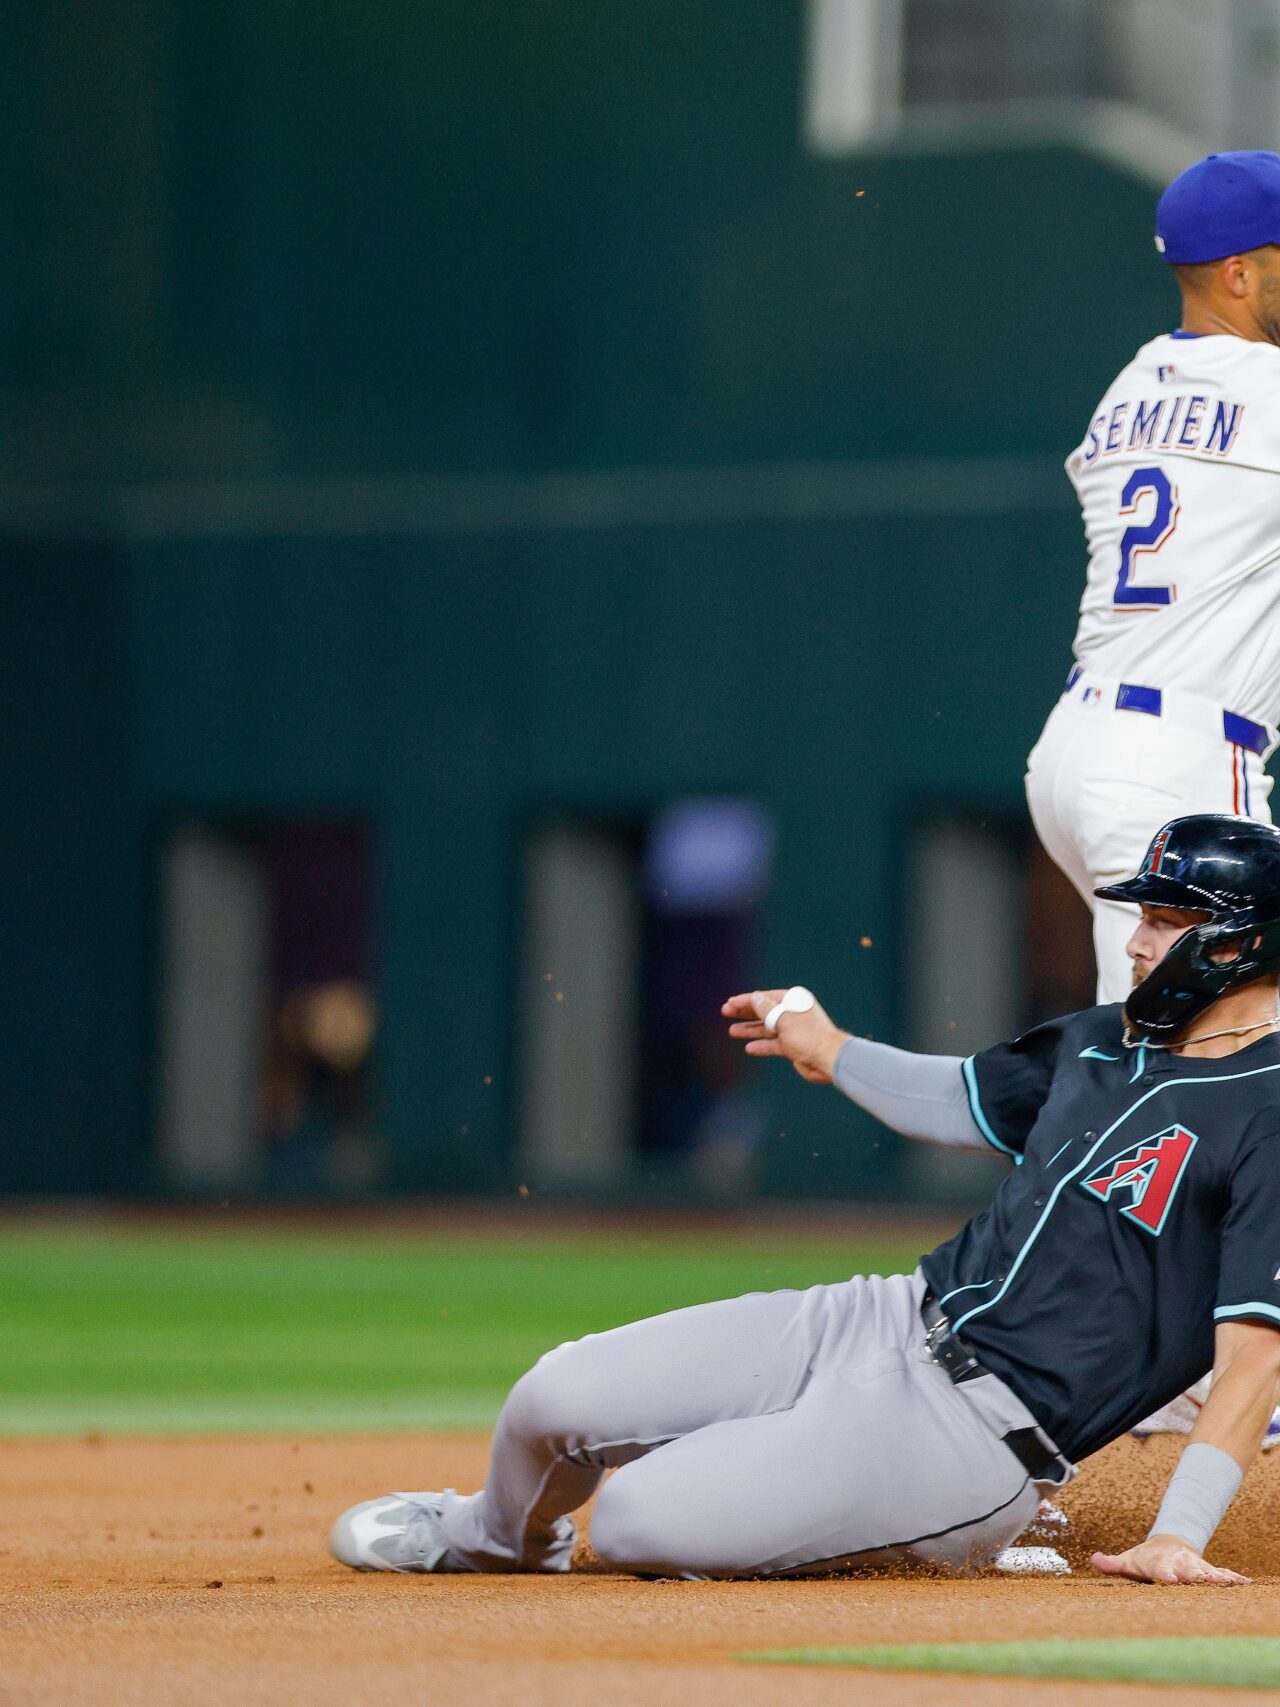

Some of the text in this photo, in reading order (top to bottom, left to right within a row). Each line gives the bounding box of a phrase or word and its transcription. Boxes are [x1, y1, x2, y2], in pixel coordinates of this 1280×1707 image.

[1085, 396, 1246, 466] SEMIEN
[1113, 466, 1181, 612] 2
[1080, 1123, 1199, 1236] A
